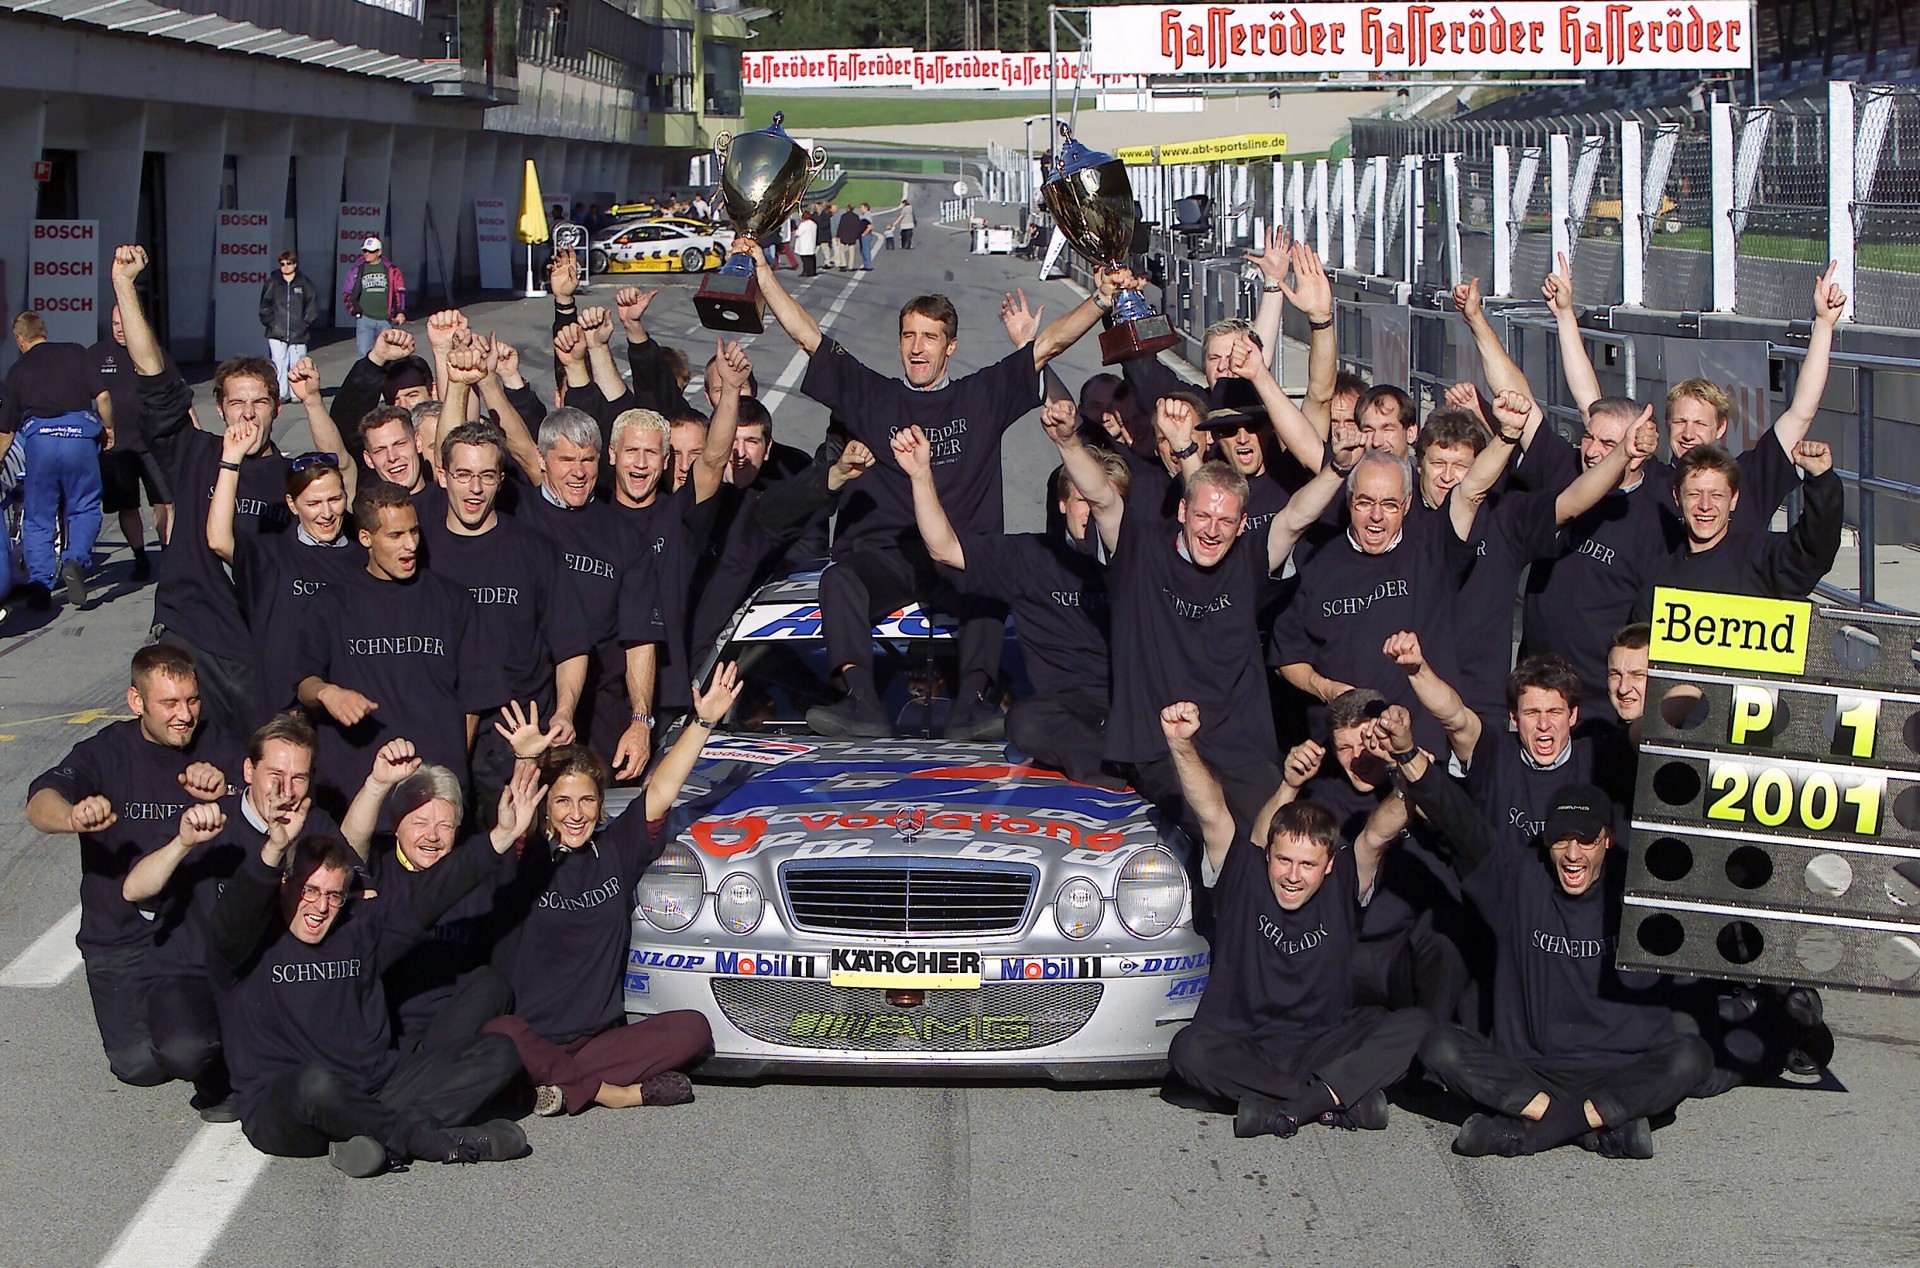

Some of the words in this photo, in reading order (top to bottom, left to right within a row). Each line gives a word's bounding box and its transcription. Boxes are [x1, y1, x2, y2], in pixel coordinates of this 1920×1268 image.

[1161, 136, 1286, 157] www.abt-sportsline.de
[221, 214, 268, 226] BOSCH
[341, 206, 381, 216] BOSCH
[34, 225, 94, 239] BOSCH
[220, 243, 268, 255] BOSCH
[34, 261, 93, 276] BOSCH
[220, 271, 267, 283] BOSCH
[34, 297, 93, 312] BOSCH
[889, 418, 968, 443] SEIDER
[1661, 602, 1795, 654] Bernd
[1731, 685, 1774, 745] P
[1841, 699, 1879, 759] 1
[705, 751, 775, 762] vodafone
[1707, 762, 1882, 836] 2001
[797, 808, 1126, 851] vodafone
[715, 951, 788, 976] Mobil
[831, 948, 981, 974] KÄRCHER
[1001, 957, 1074, 980] Mobil
[862, 1013, 1030, 1041] AMG
